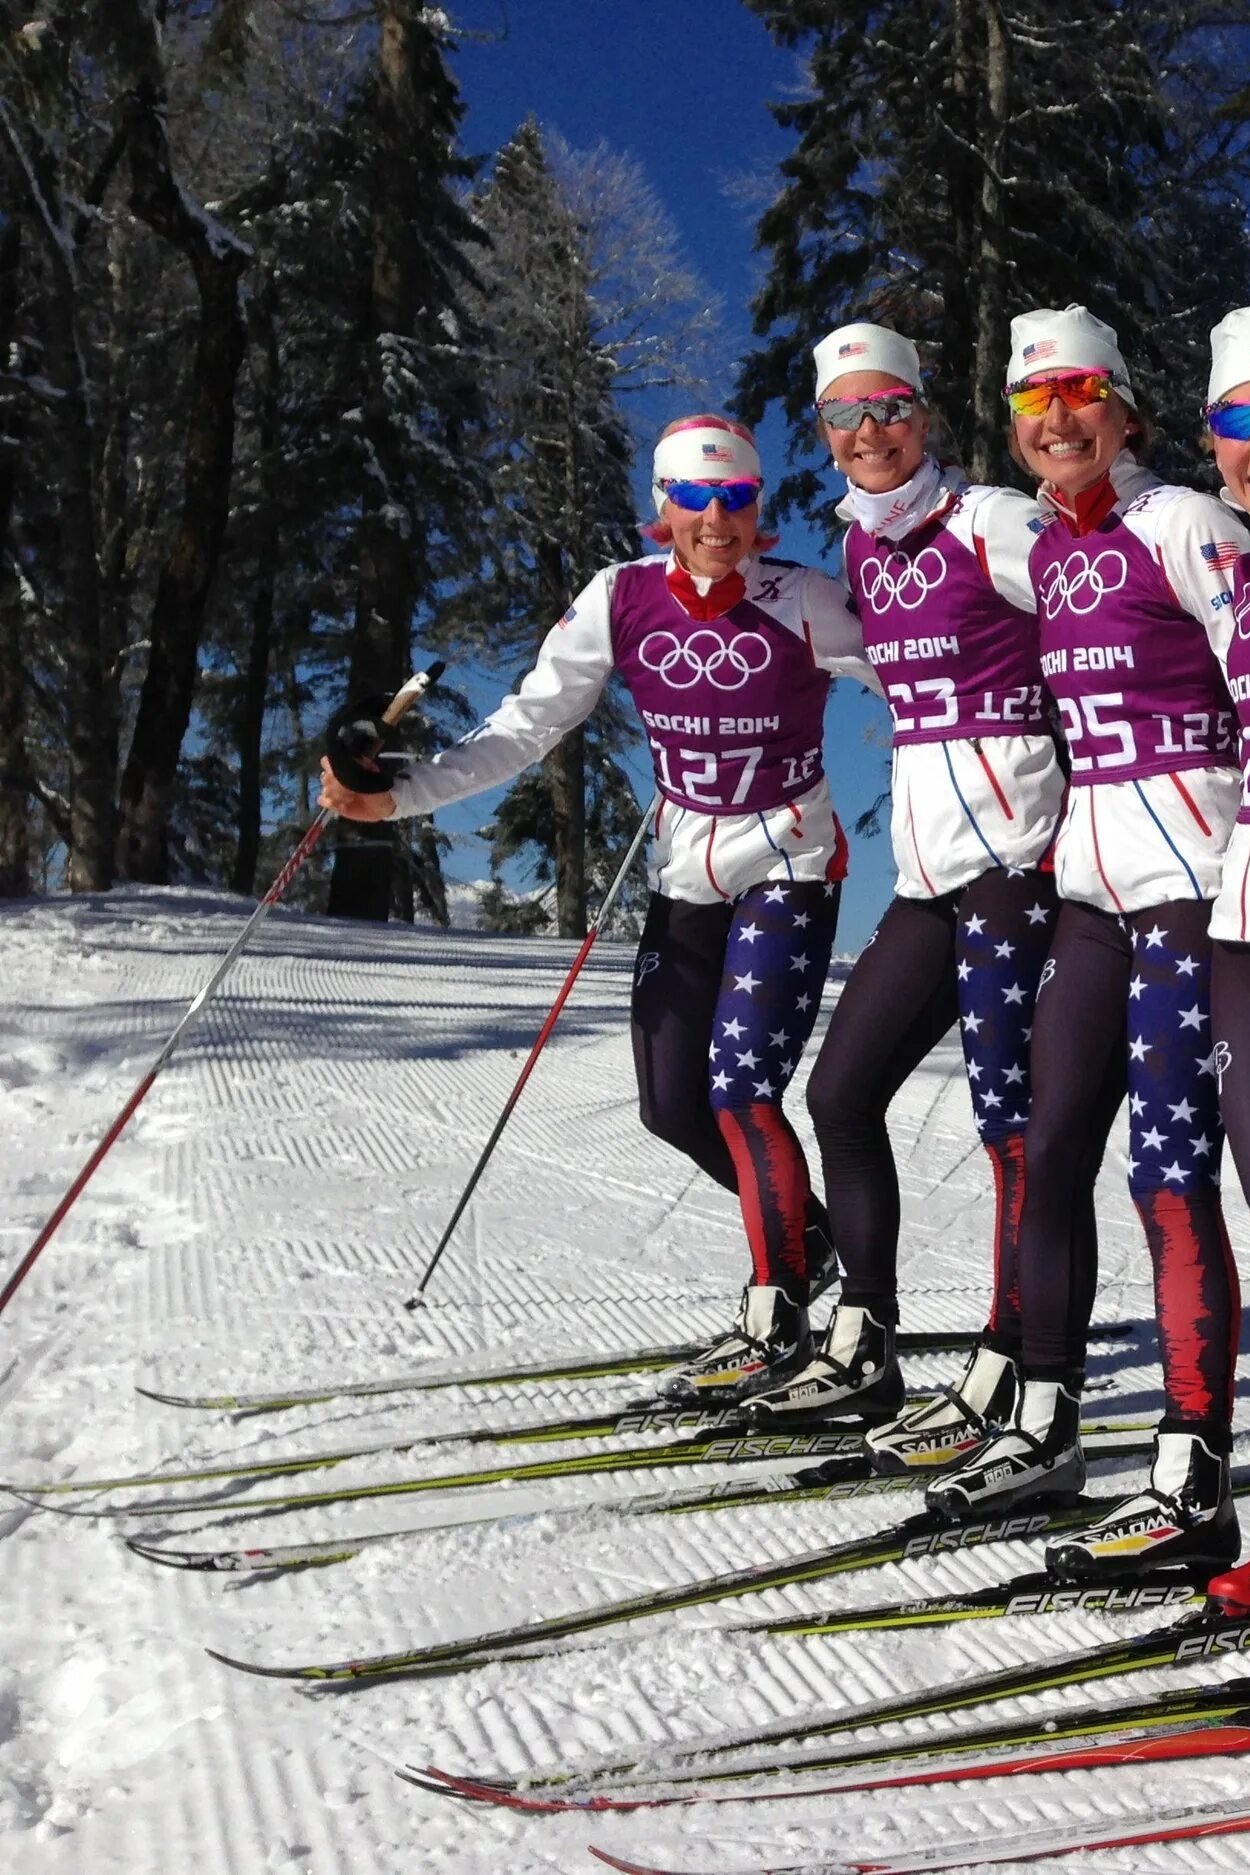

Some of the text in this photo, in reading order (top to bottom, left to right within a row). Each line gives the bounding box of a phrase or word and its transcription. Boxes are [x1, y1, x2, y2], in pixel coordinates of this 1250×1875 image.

[865, 635, 960, 665] OCHI 2014
[1039, 645, 1135, 677] OCHI 2014
[888, 677, 960, 733] 23
[642, 709, 780, 736] SOCHI 2014
[1057, 692, 1138, 772] 25
[650, 735, 764, 805] 127
[613, 1407, 741, 1434] FISCHE
[701, 1431, 866, 1462] FISCHER
